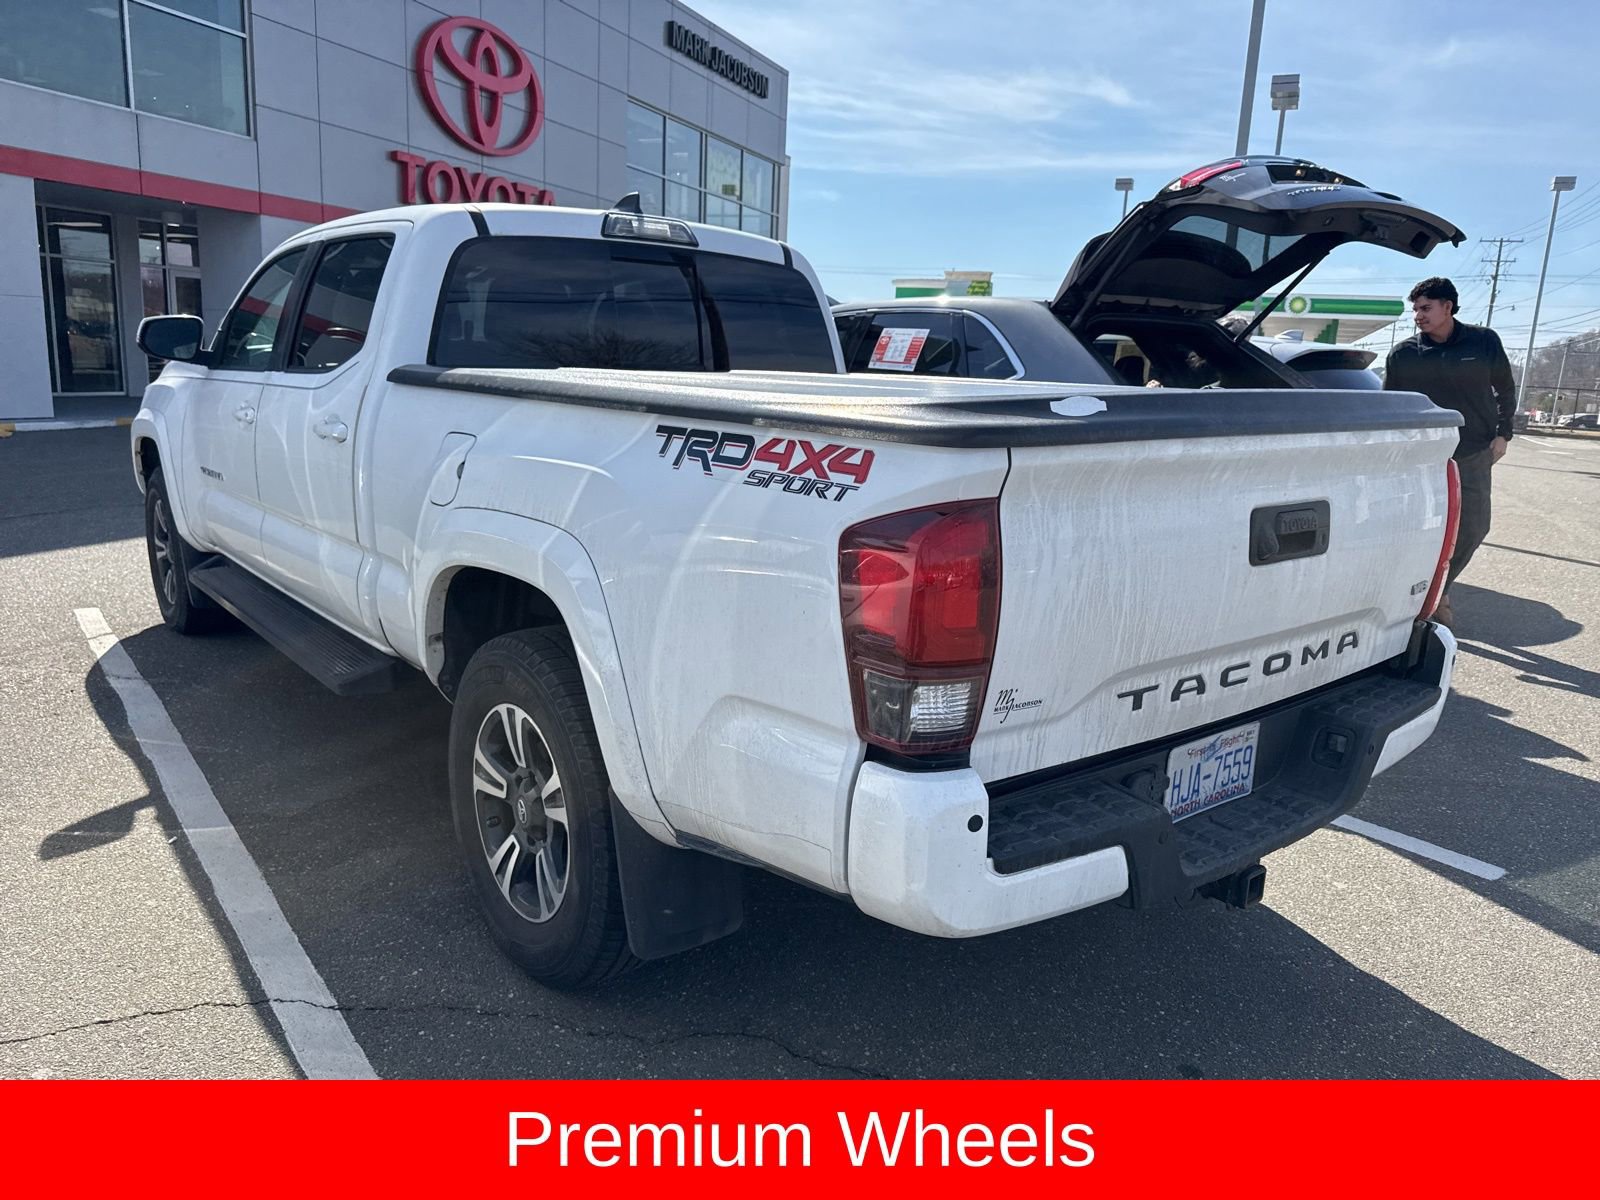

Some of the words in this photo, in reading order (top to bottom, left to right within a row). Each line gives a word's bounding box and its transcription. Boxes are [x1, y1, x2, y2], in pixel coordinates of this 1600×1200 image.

[664, 20, 711, 66] MARK
[709, 46, 769, 99] JACOBSON
[743, 469, 861, 502] SPORT
[1281, 516, 1319, 532] TOYOTA
[1117, 631, 1360, 712] TACOMA
[1011, 699, 1043, 711] JACOBSON
[1170, 744, 1253, 808] HJA-7559
[1171, 799, 1201, 817] NORTH
[1203, 783, 1245, 806] CAROLINA
